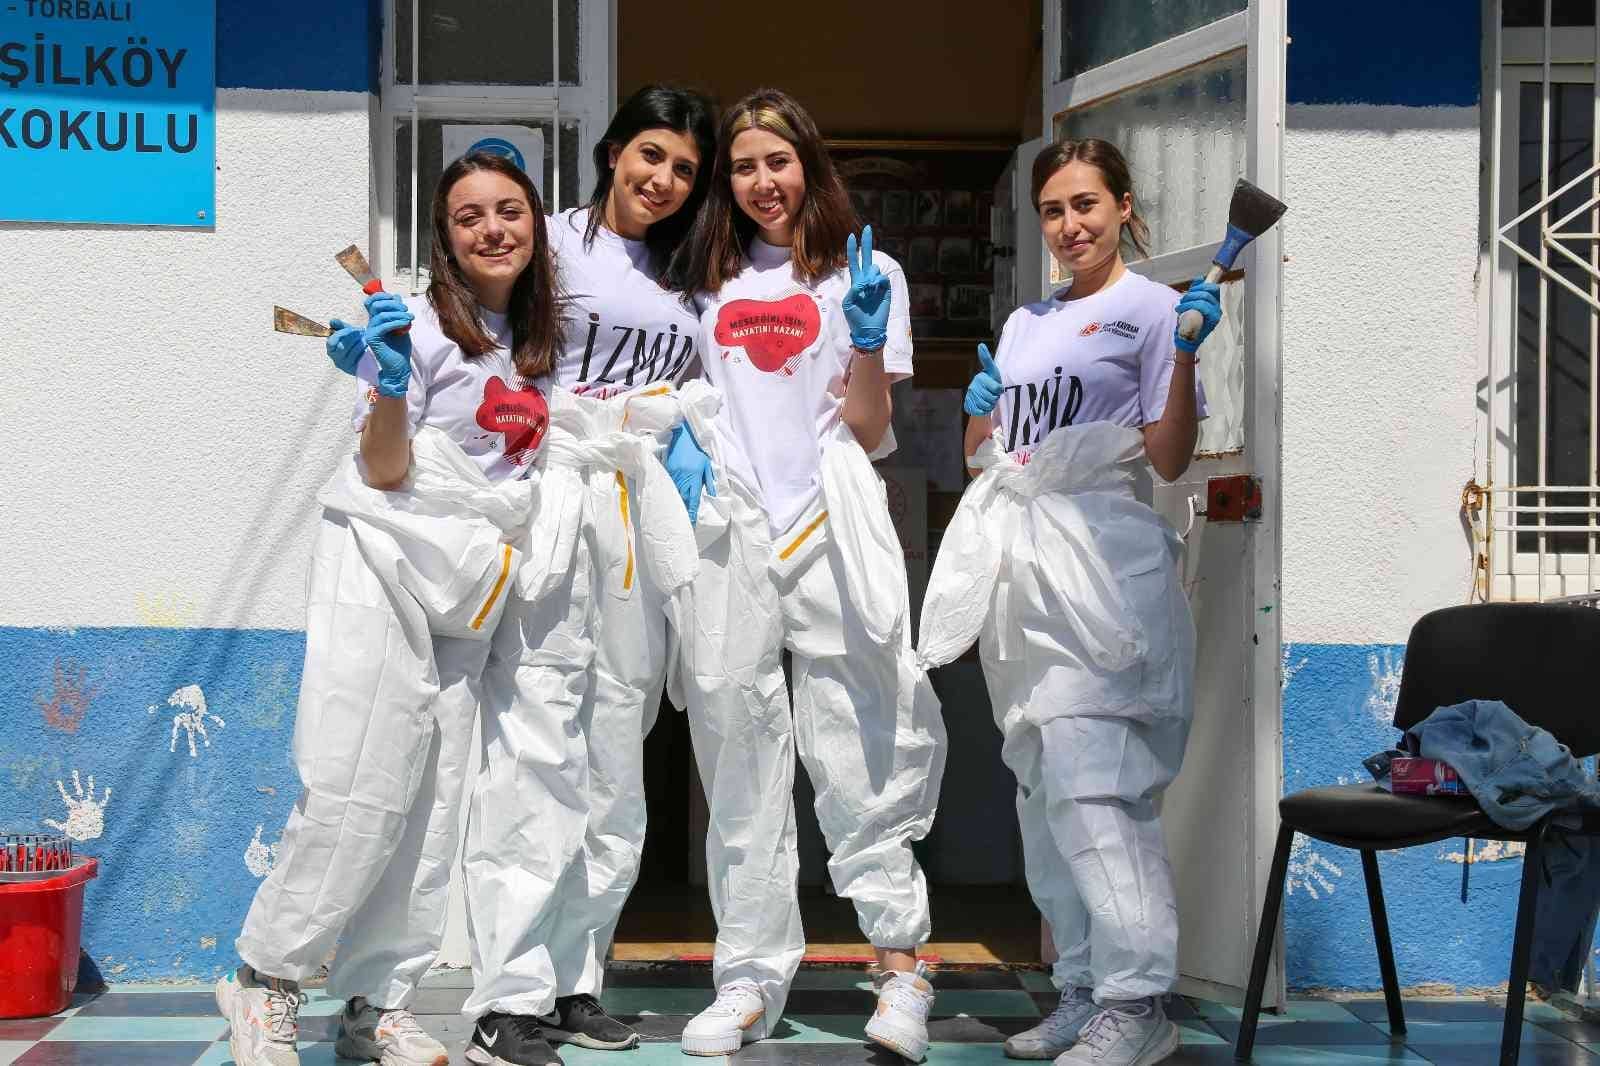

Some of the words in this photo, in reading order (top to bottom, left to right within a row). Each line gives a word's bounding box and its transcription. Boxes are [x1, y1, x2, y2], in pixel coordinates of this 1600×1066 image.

[24, 0, 131, 21] TORBALI
[0, 33, 188, 88] ŞİLKÖY
[1003, 366, 1083, 454] ZMİR
